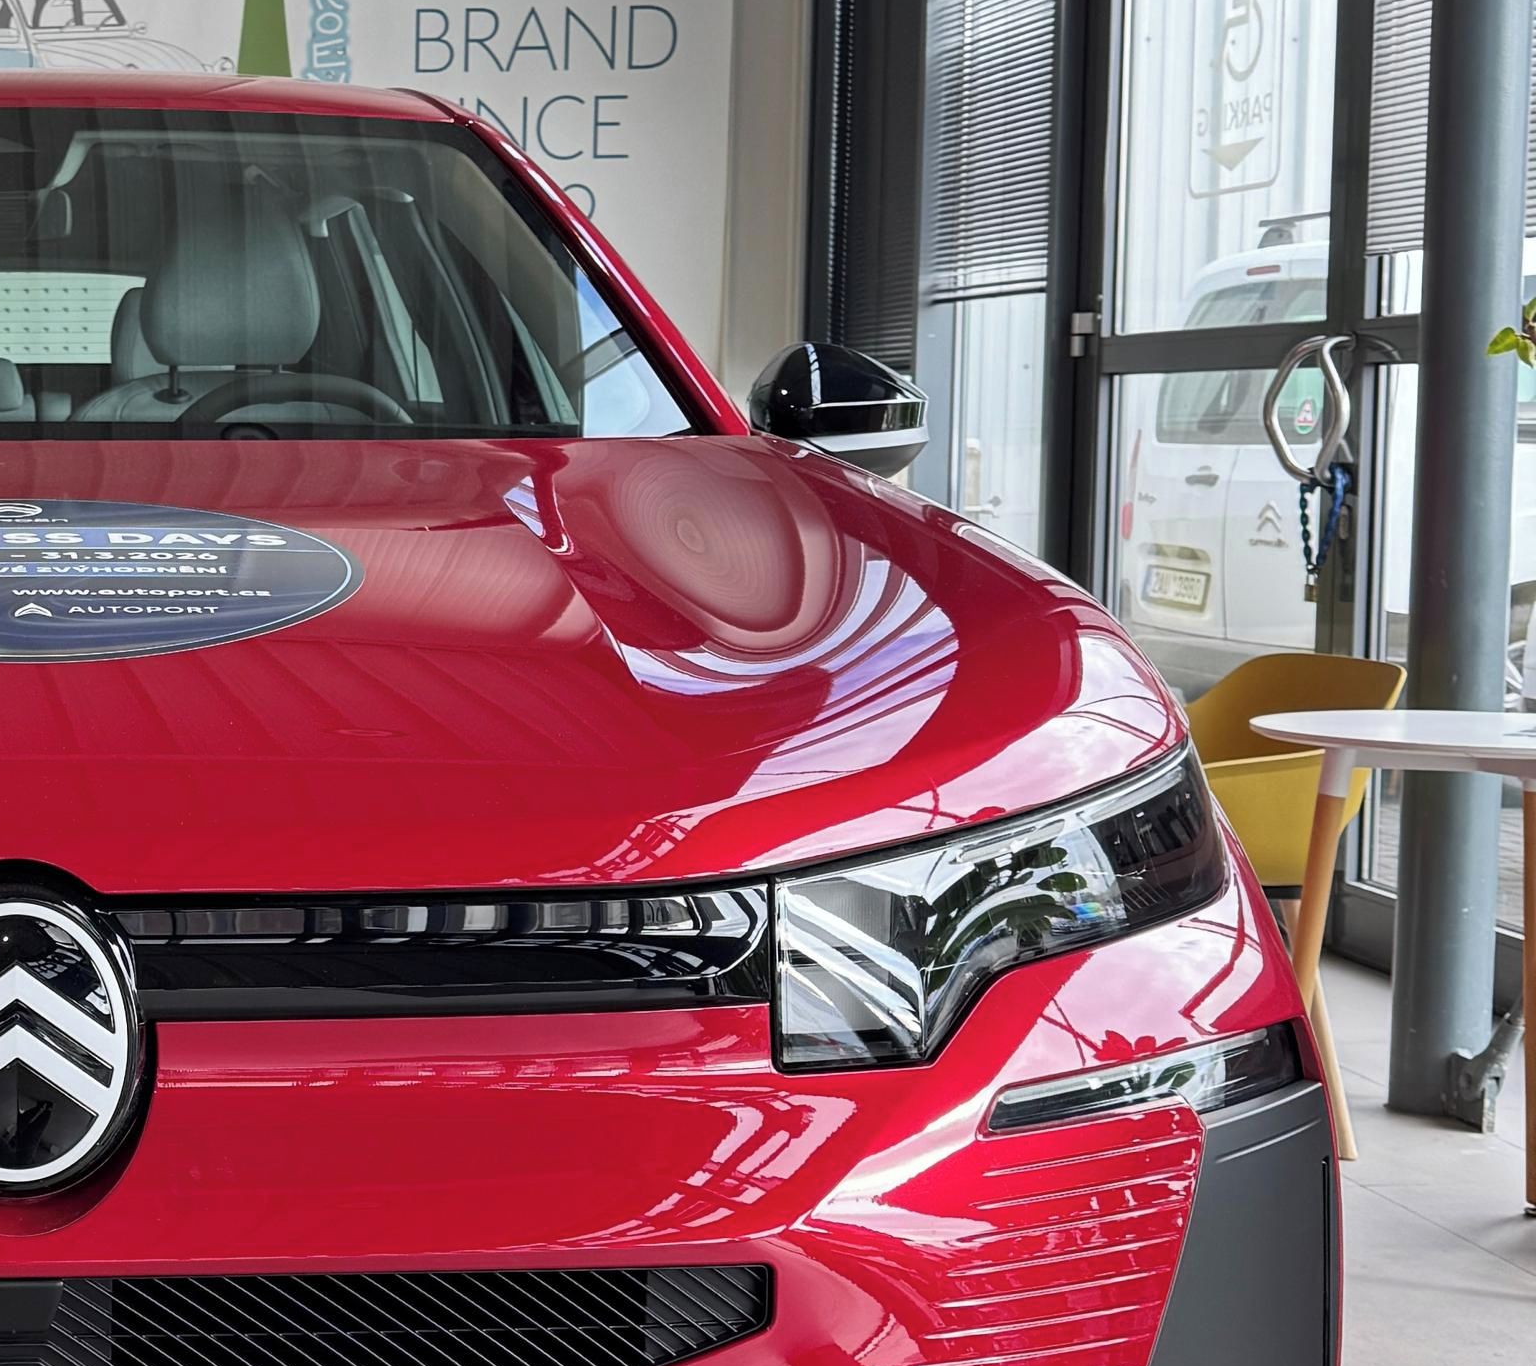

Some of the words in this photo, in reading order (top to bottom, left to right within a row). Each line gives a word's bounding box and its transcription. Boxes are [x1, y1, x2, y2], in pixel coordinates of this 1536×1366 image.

[415, 4, 678, 73] BRAND
[460, 94, 630, 160] NCE
[107, 532, 287, 547] DAYS
[41, 551, 219, 561] 31.3.2026
[12, 588, 272, 598] www.autoport.cz
[68, 605, 219, 614] AUTOPORT
